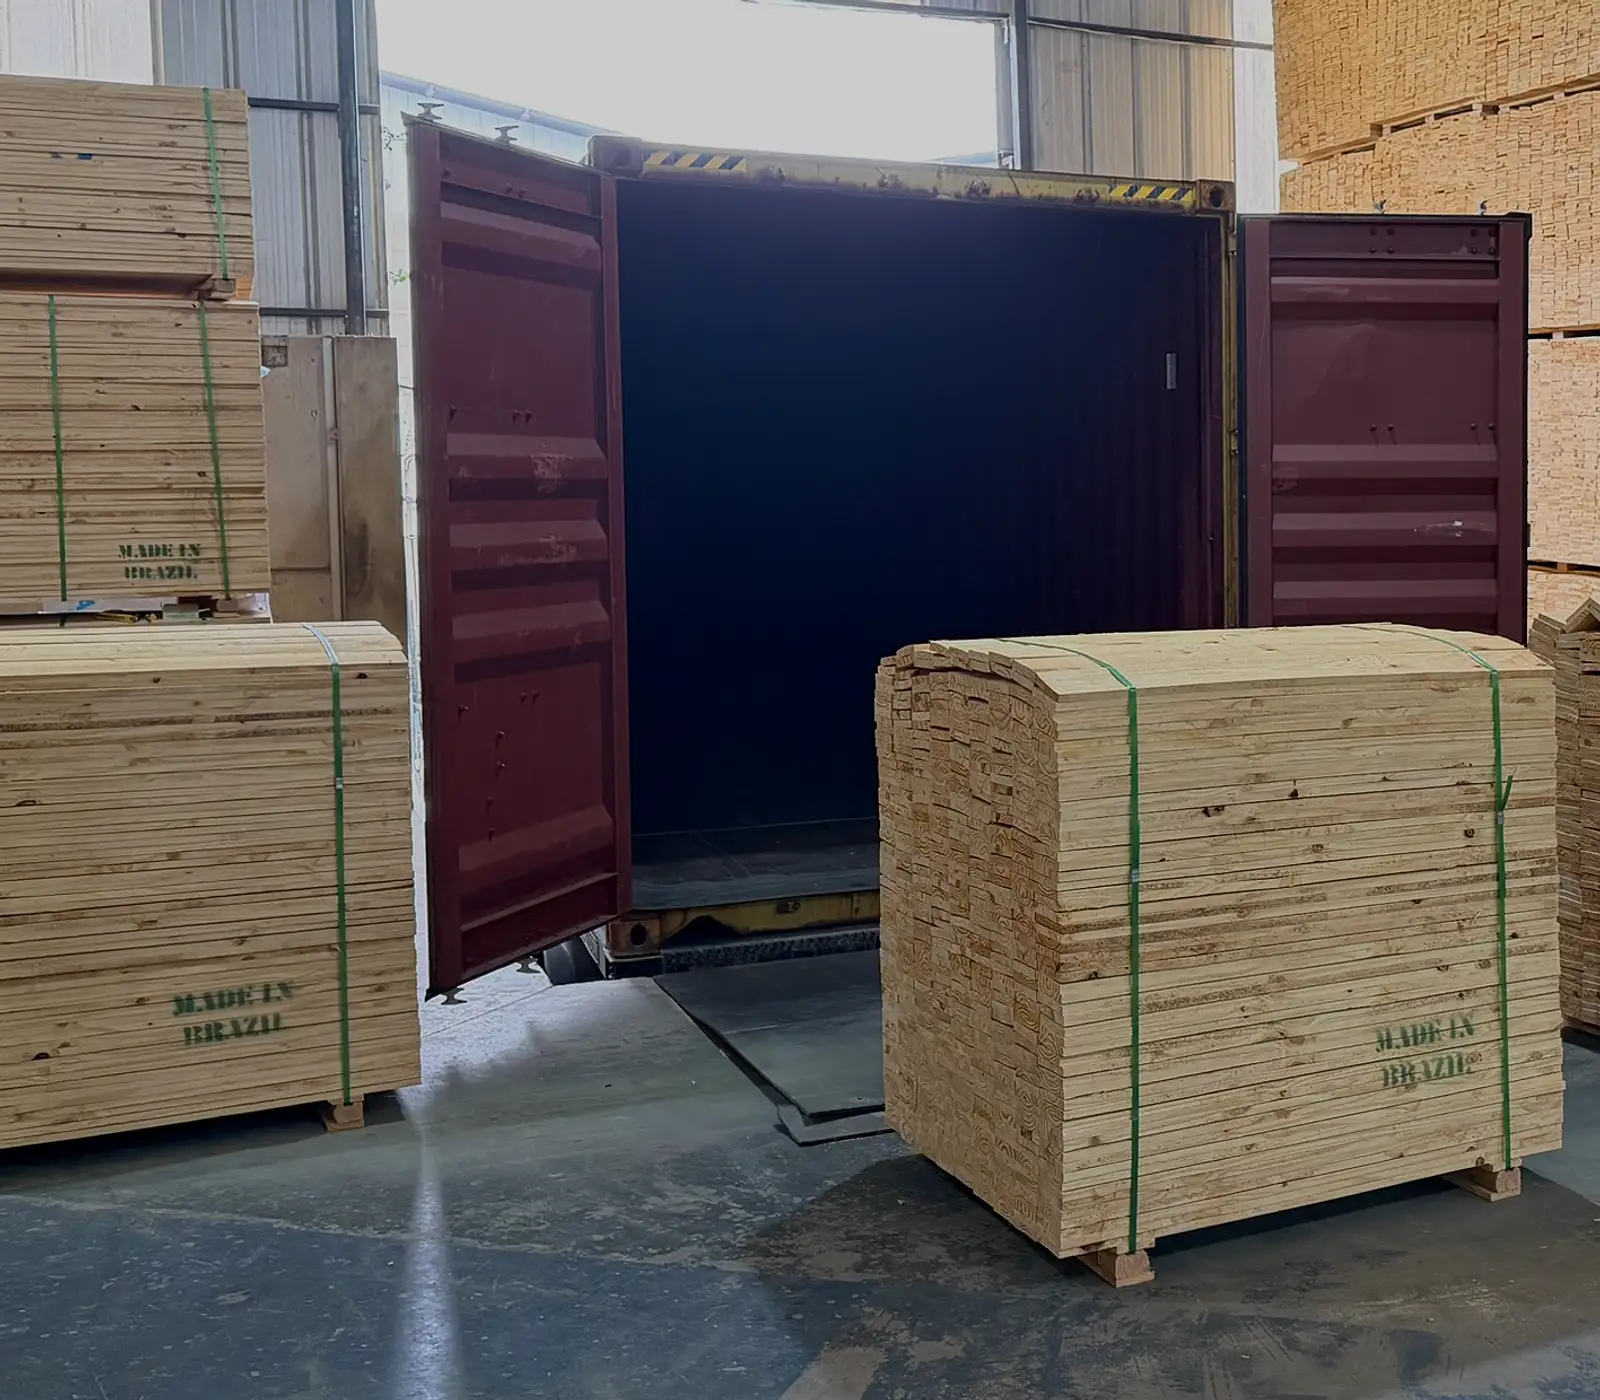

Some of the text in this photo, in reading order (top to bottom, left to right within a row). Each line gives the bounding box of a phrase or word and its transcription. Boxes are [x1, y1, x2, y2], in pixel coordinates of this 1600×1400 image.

[118, 543, 201, 558] MADE IN
[124, 565, 198, 580] BRAZIL
[173, 986, 255, 1016] MADE
[1376, 1011, 1475, 1053] MADE IN
[1383, 1051, 1472, 1087] BRAZIL
